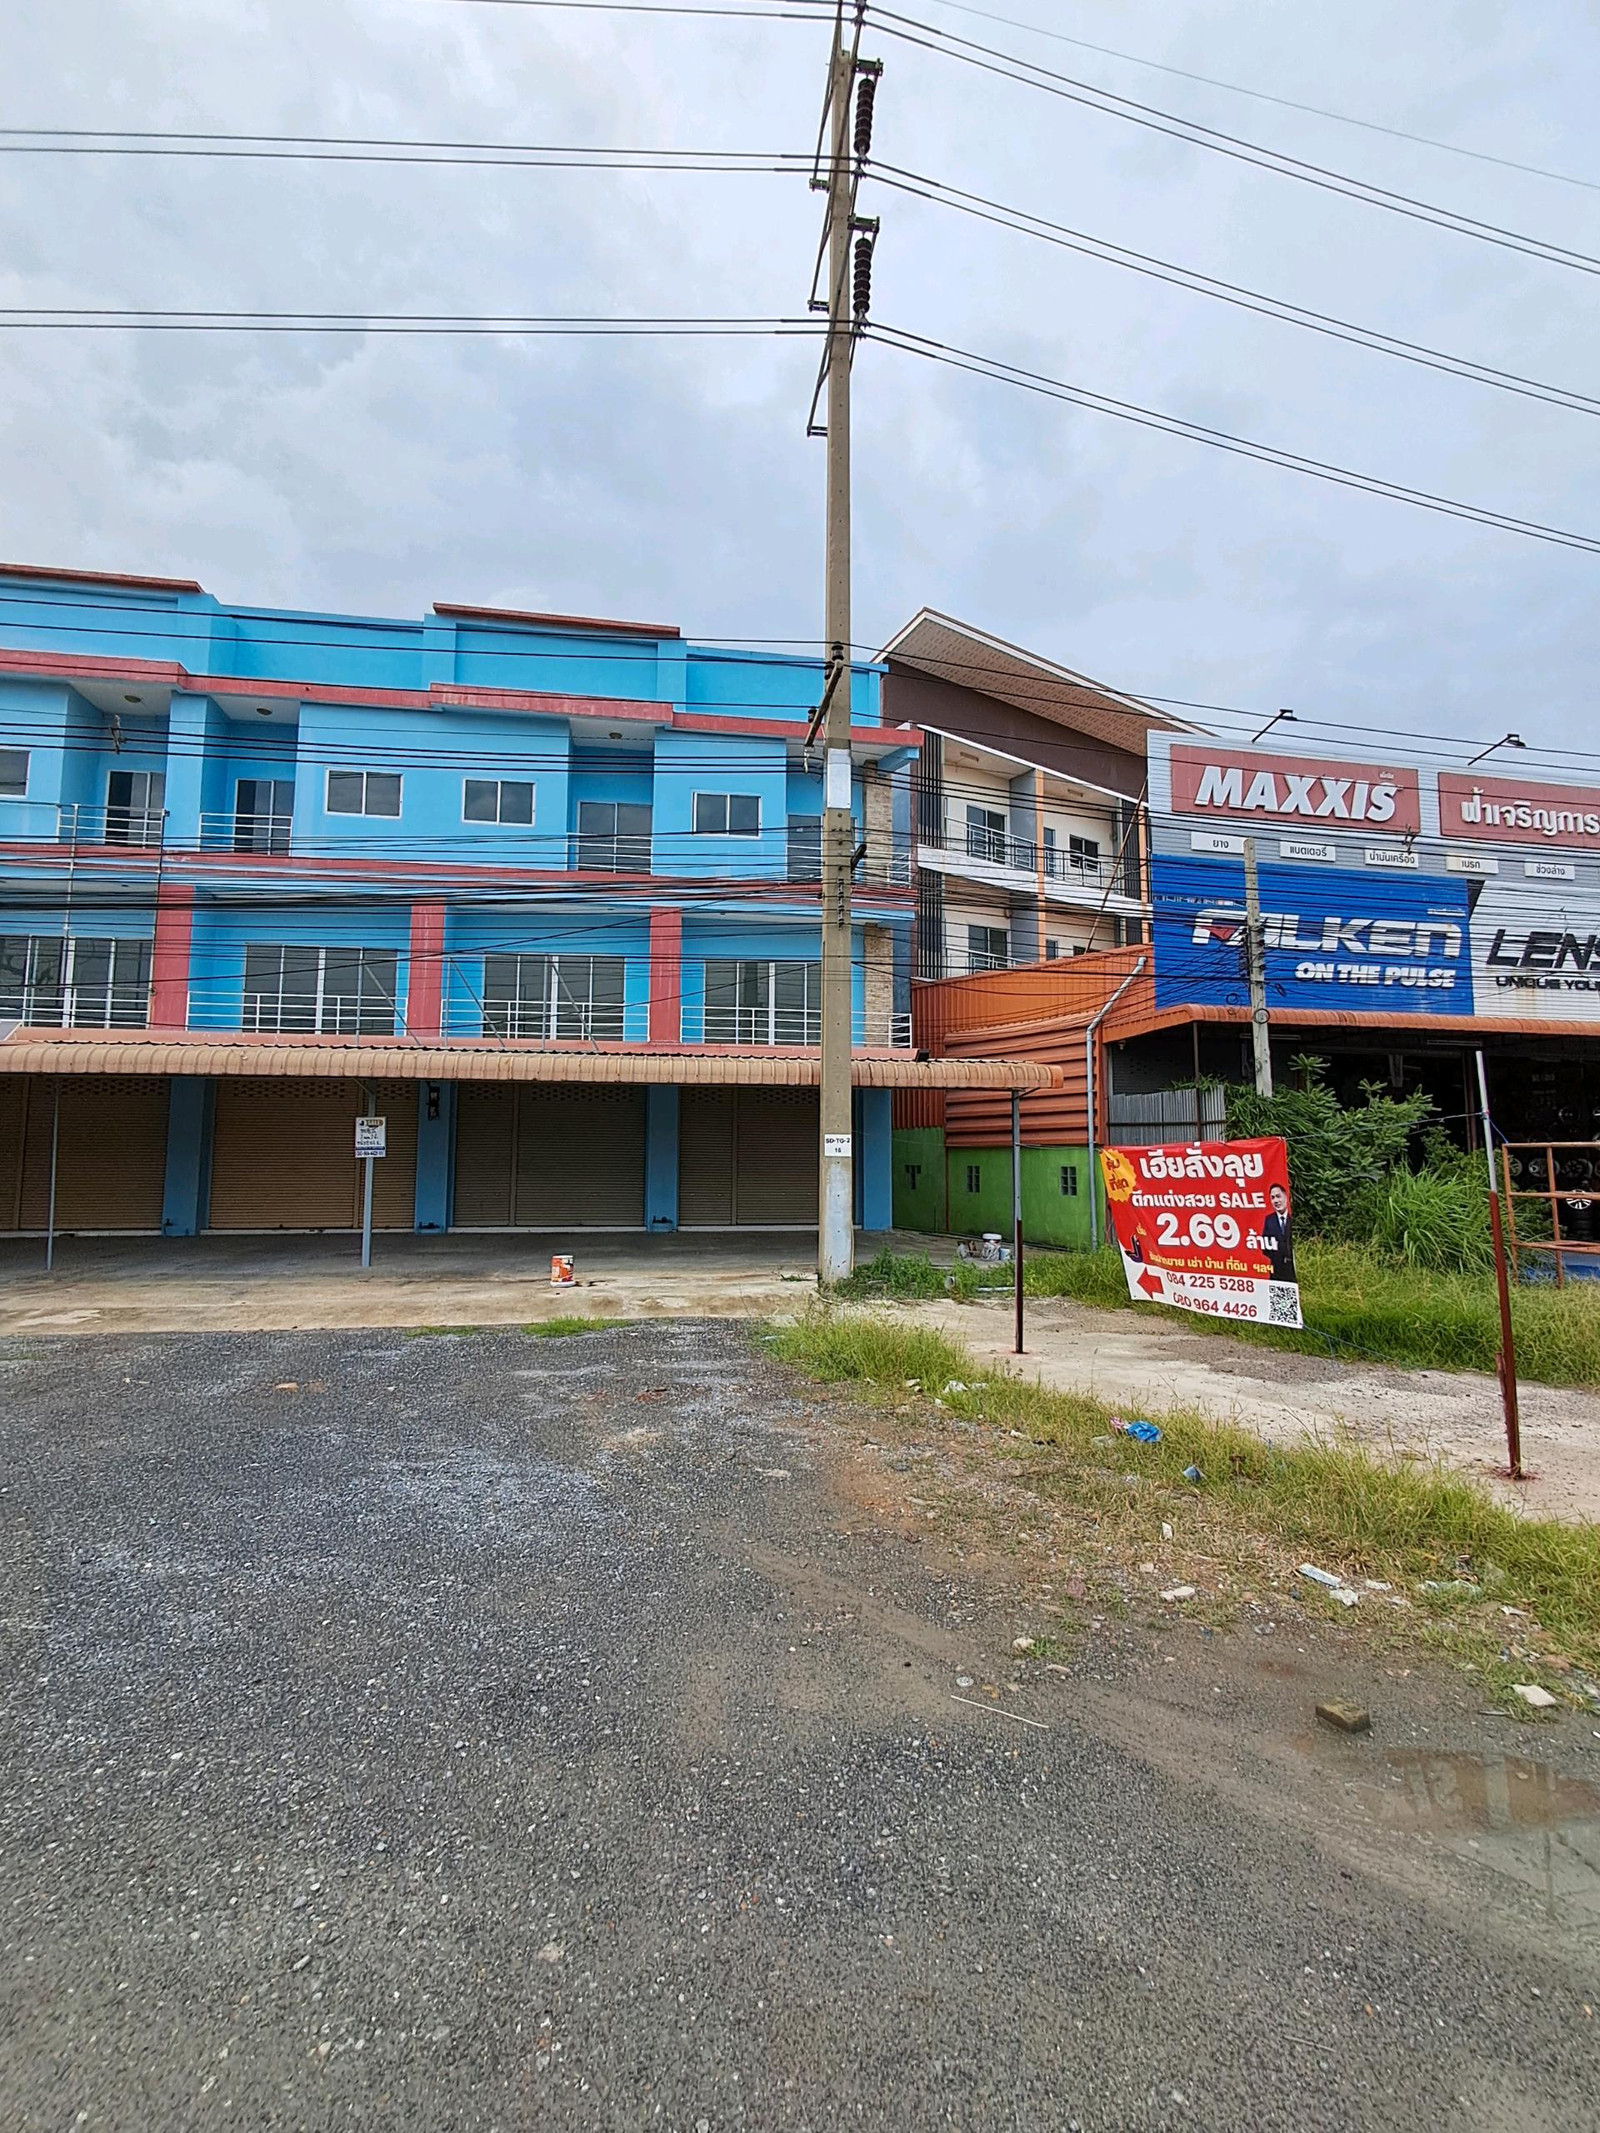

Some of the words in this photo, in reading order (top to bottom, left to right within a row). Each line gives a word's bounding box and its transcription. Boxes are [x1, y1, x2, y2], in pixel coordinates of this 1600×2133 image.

[1194, 765, 1399, 823] MAXXIS
[1294, 961, 1333, 984] ON
[1336, 963, 1379, 985] THE
[1383, 966, 1456, 988] PULSE
[1139, 1141, 1264, 1188] เฮียสั่งลุย
[1131, 1189, 1216, 1208] ตึกแต่งสวย
[1219, 1192, 1266, 1208] SALE
[1156, 1212, 1240, 1249] 2.69
[1246, 1228, 1278, 1251] ล้าน
[1189, 1275, 1215, 1289] 225
[1219, 1277, 1255, 1293] 5288
[1193, 1298, 1219, 1313] 964
[1223, 1301, 1257, 1318] 4426
